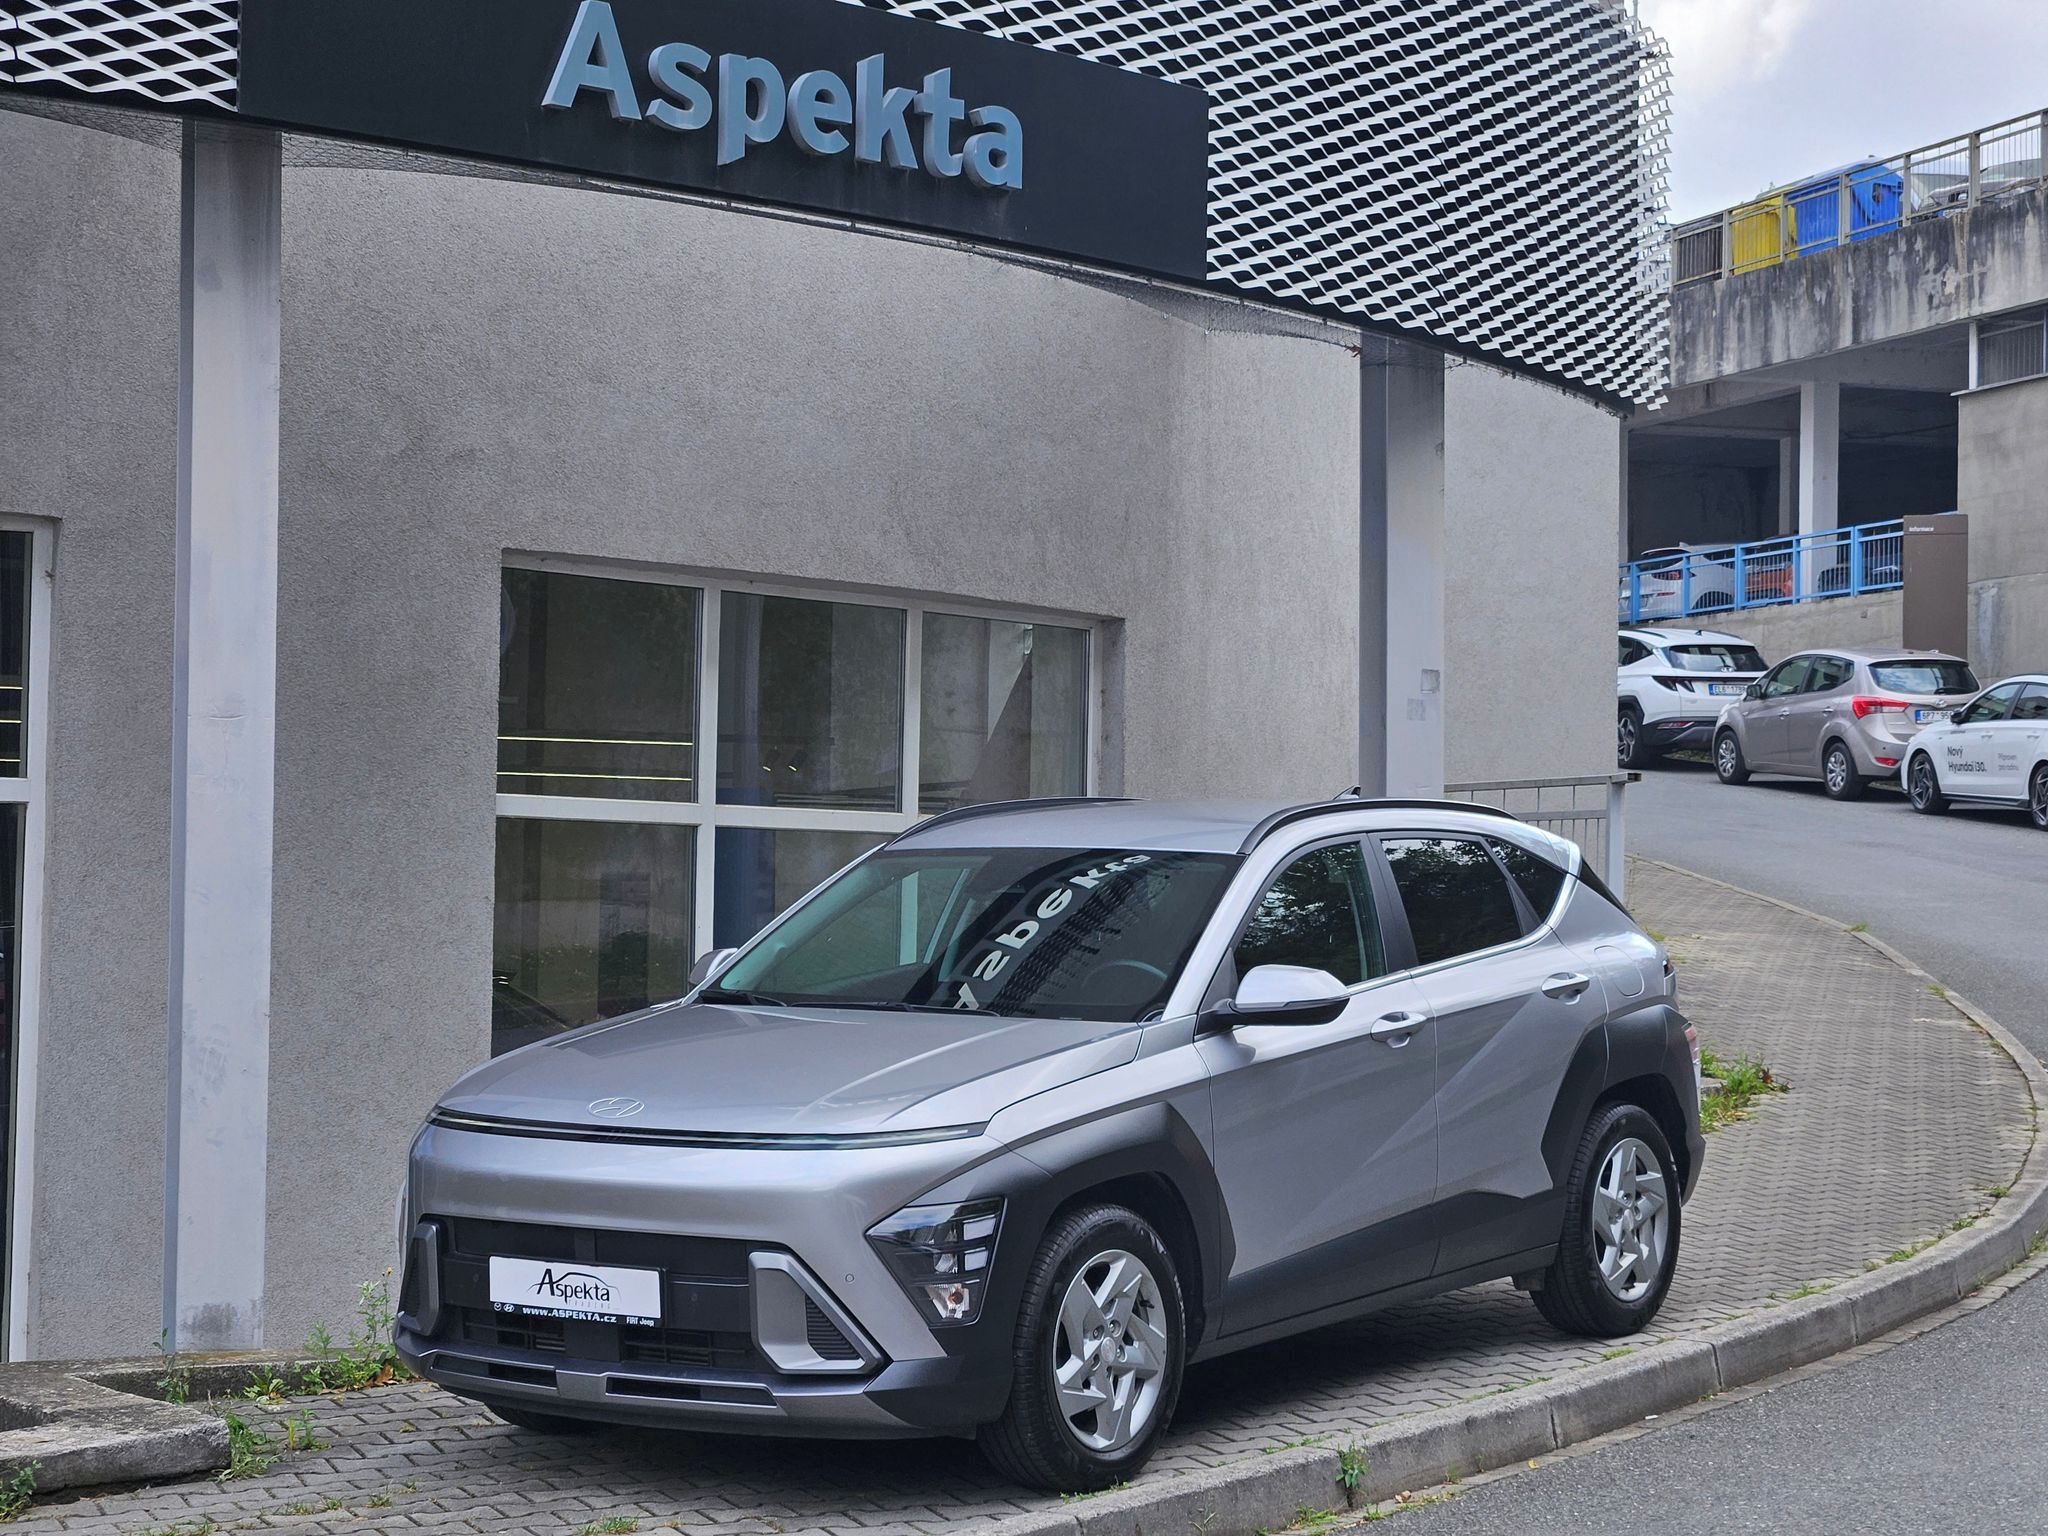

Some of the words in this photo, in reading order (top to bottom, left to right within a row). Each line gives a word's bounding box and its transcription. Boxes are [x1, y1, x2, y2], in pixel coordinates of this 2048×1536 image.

[541, 0, 1023, 190] Aspekta
[1947, 746, 1964, 759] Nový
[1948, 760, 1974, 773] Hyundai
[537, 1268, 610, 1304] Aspekta
[626, 1316, 638, 1325] FIAT
[639, 1318, 655, 1327] Jeep
